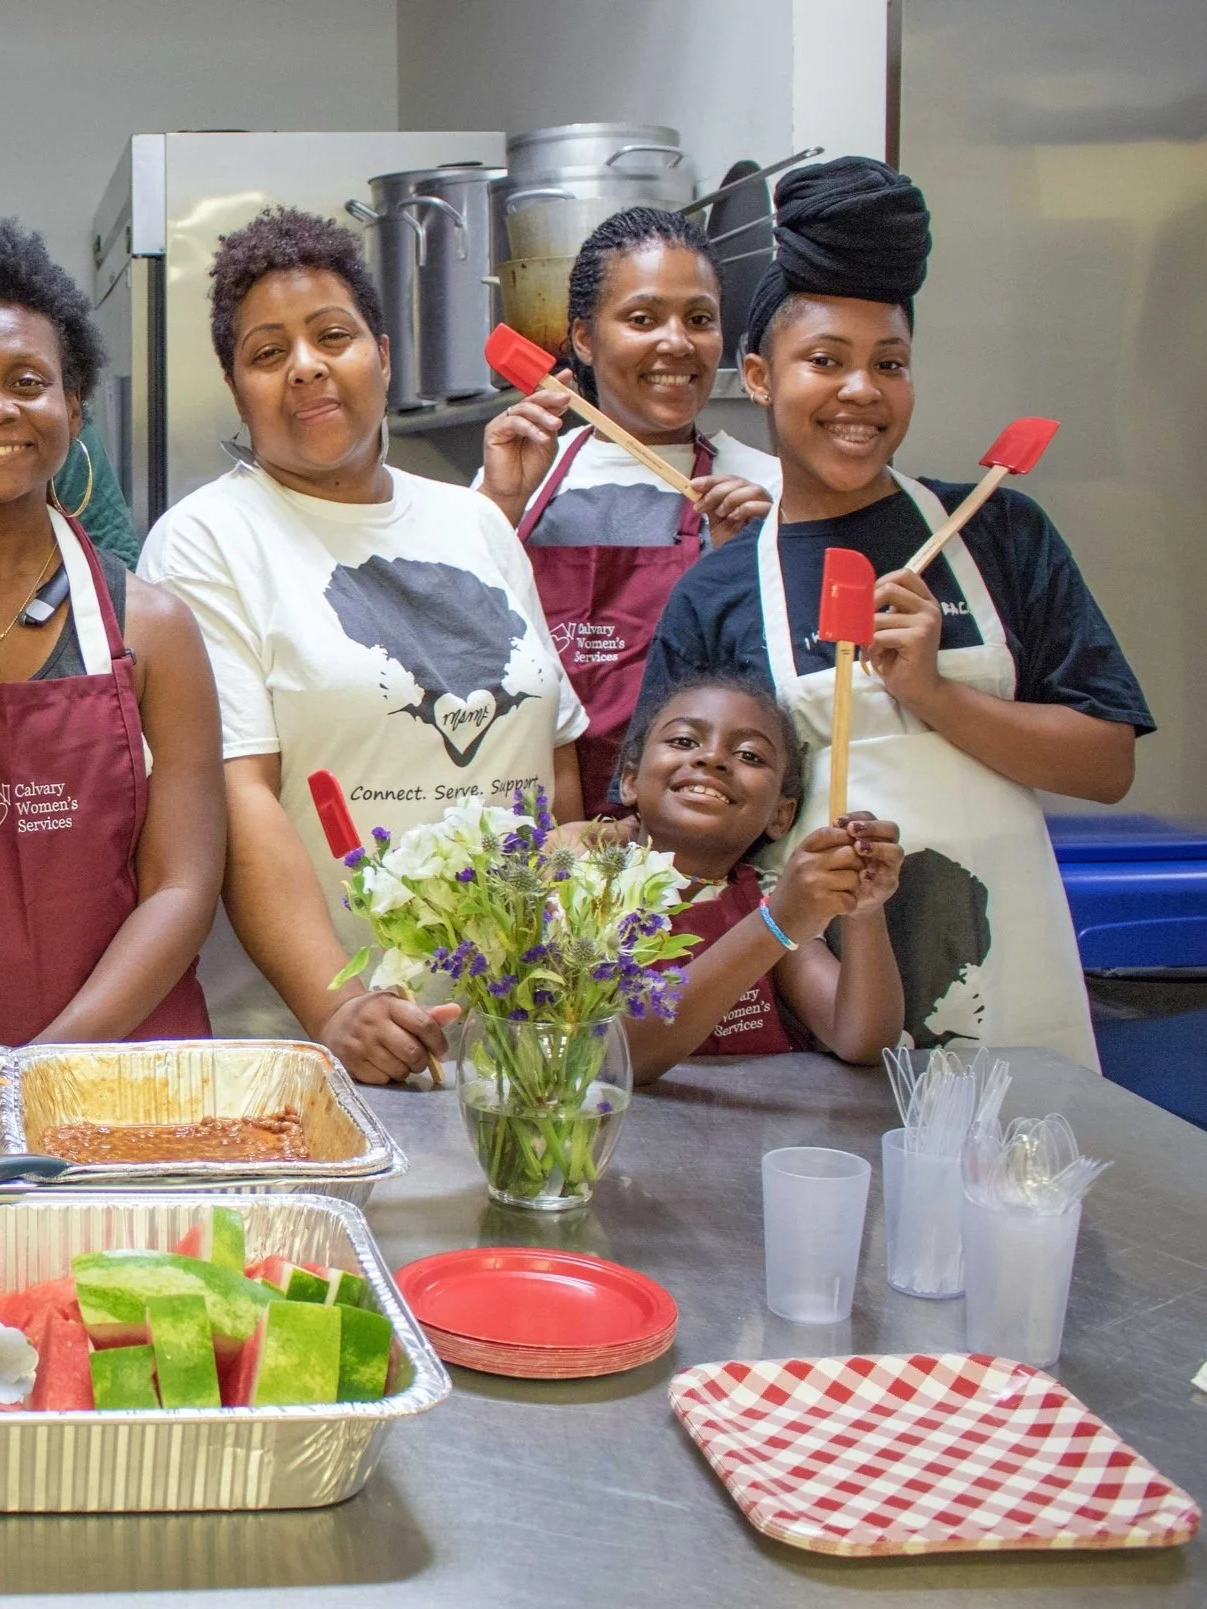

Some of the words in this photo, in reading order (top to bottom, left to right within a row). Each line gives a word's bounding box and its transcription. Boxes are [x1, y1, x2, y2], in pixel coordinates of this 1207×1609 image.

[574, 650, 618, 662] Services
[14, 781, 65, 798] Calvary
[350, 786, 426, 801] Connect.
[434, 784, 483, 800] Serve.
[15, 796, 79, 816] Women's
[18, 816, 73, 833] Services
[714, 1019, 764, 1037] Services
